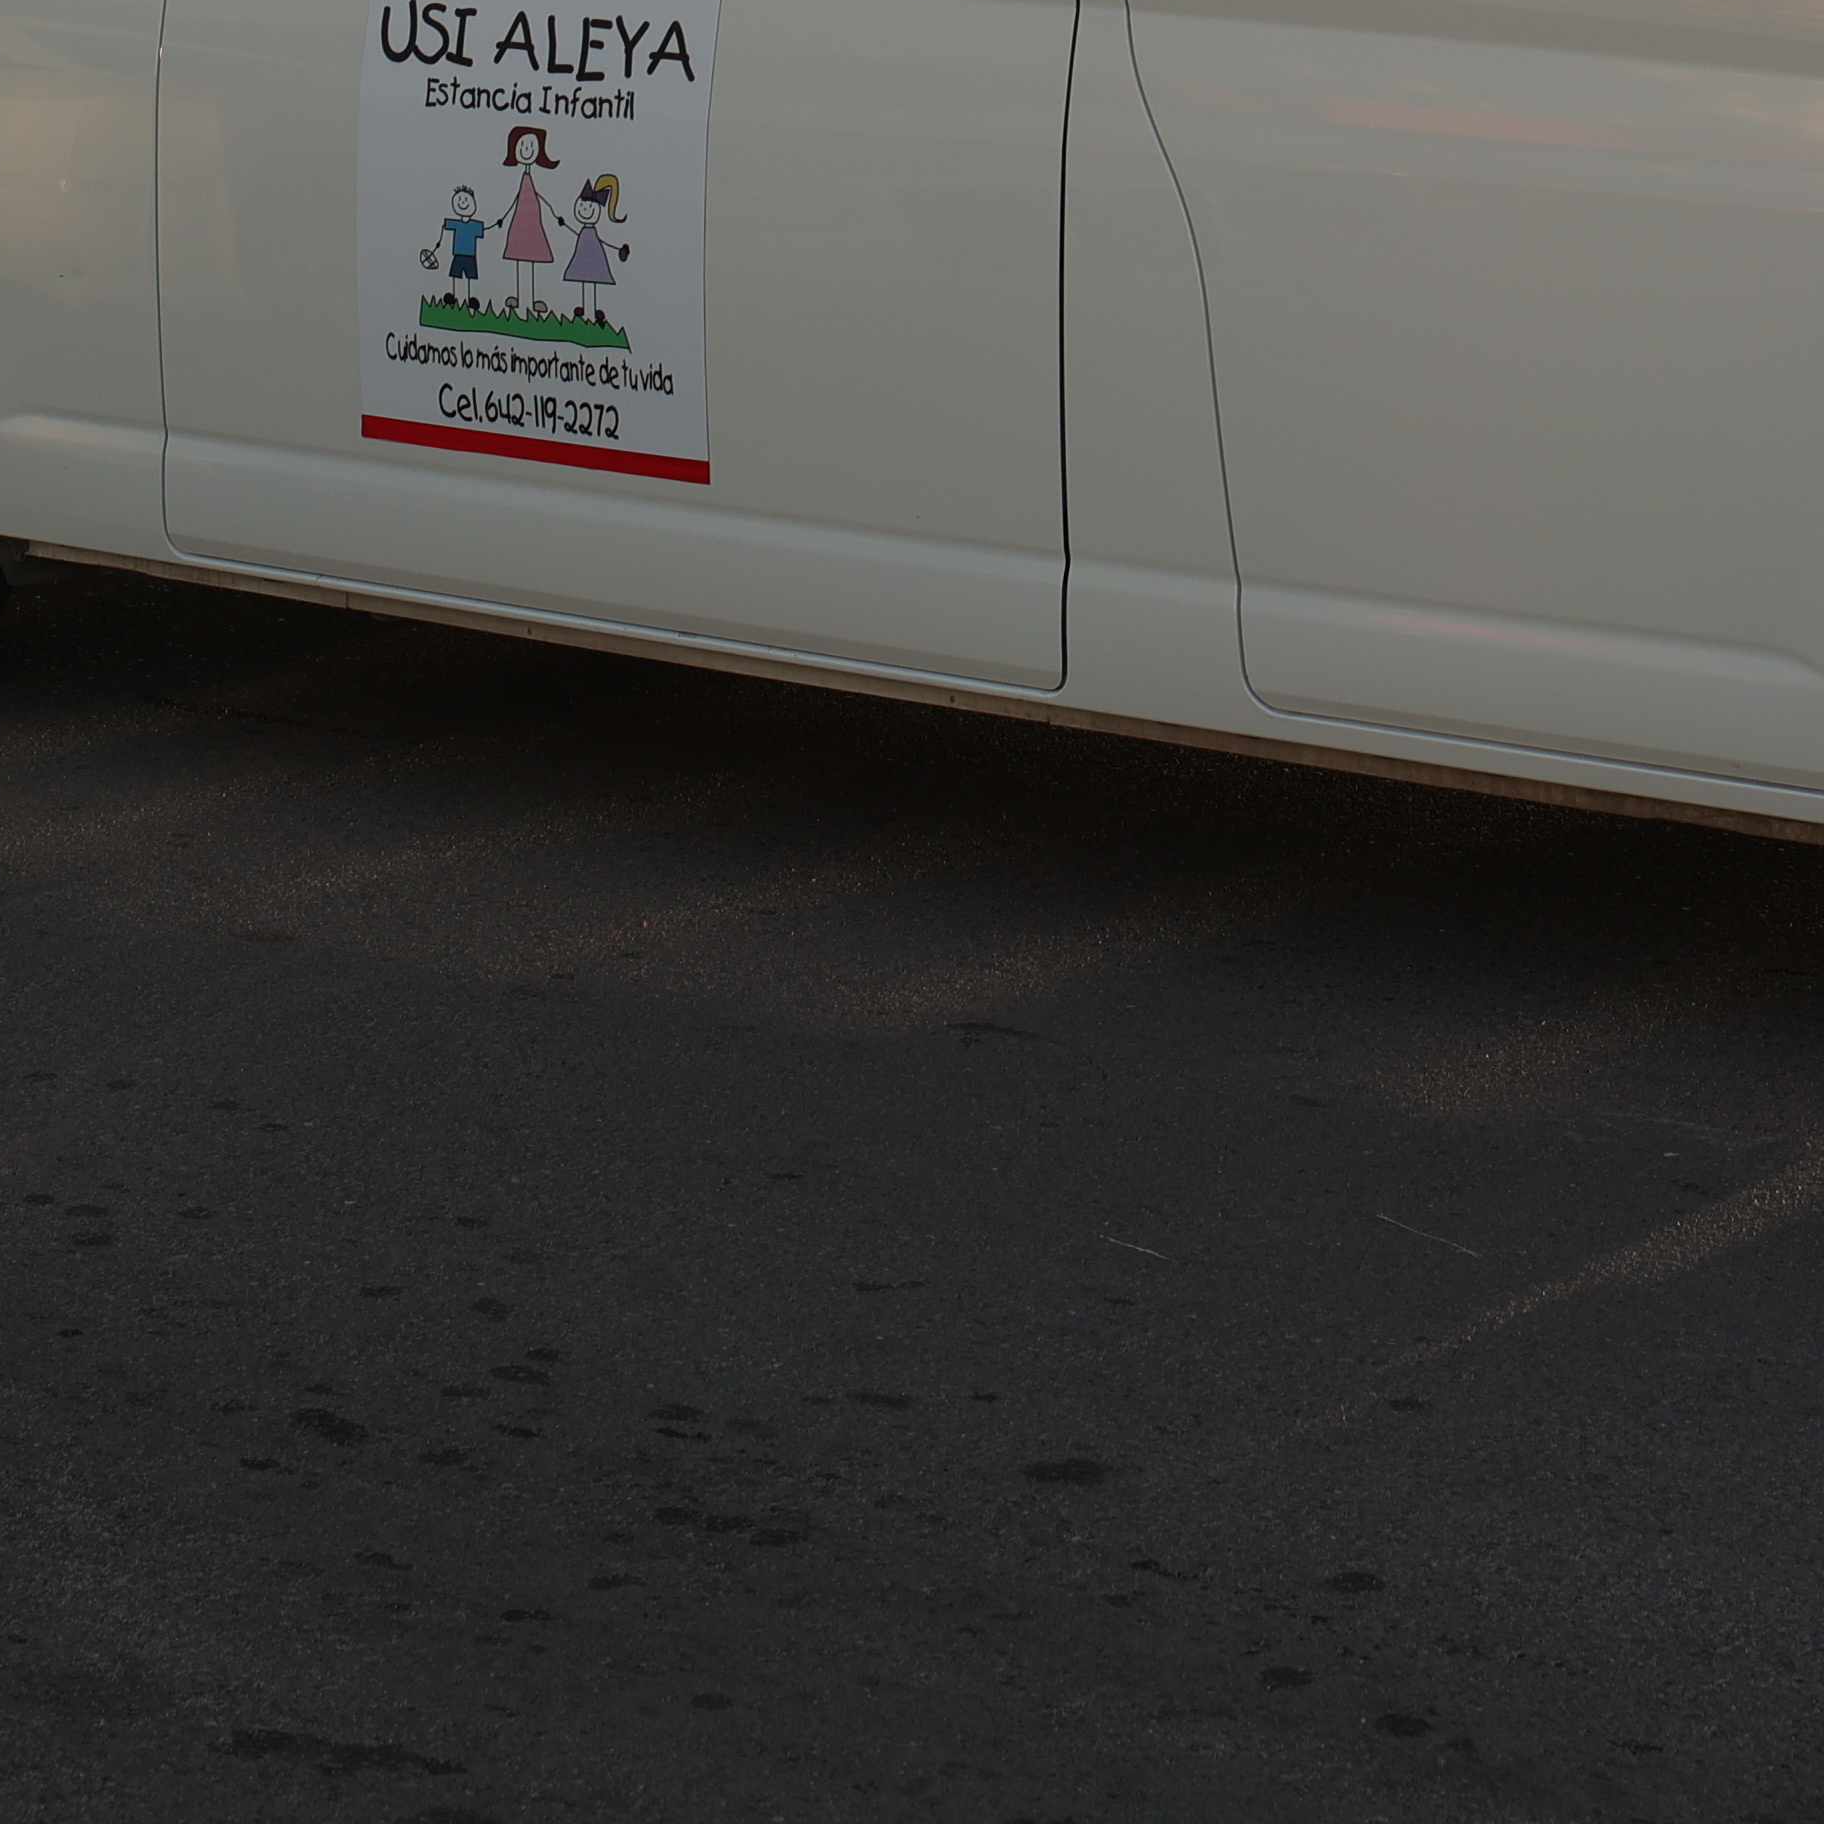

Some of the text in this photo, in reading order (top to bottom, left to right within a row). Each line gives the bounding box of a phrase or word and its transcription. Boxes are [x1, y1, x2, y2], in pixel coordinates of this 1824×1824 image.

[493, 10, 696, 82] ALEYA
[424, 76, 635, 121] Estancia Infantil
[385, 331, 458, 368] Cuidamos
[460, 340, 474, 369] lo
[476, 344, 509, 374] más
[510, 346, 597, 387] importante
[598, 356, 620, 390] de
[639, 362, 675, 396] vida
